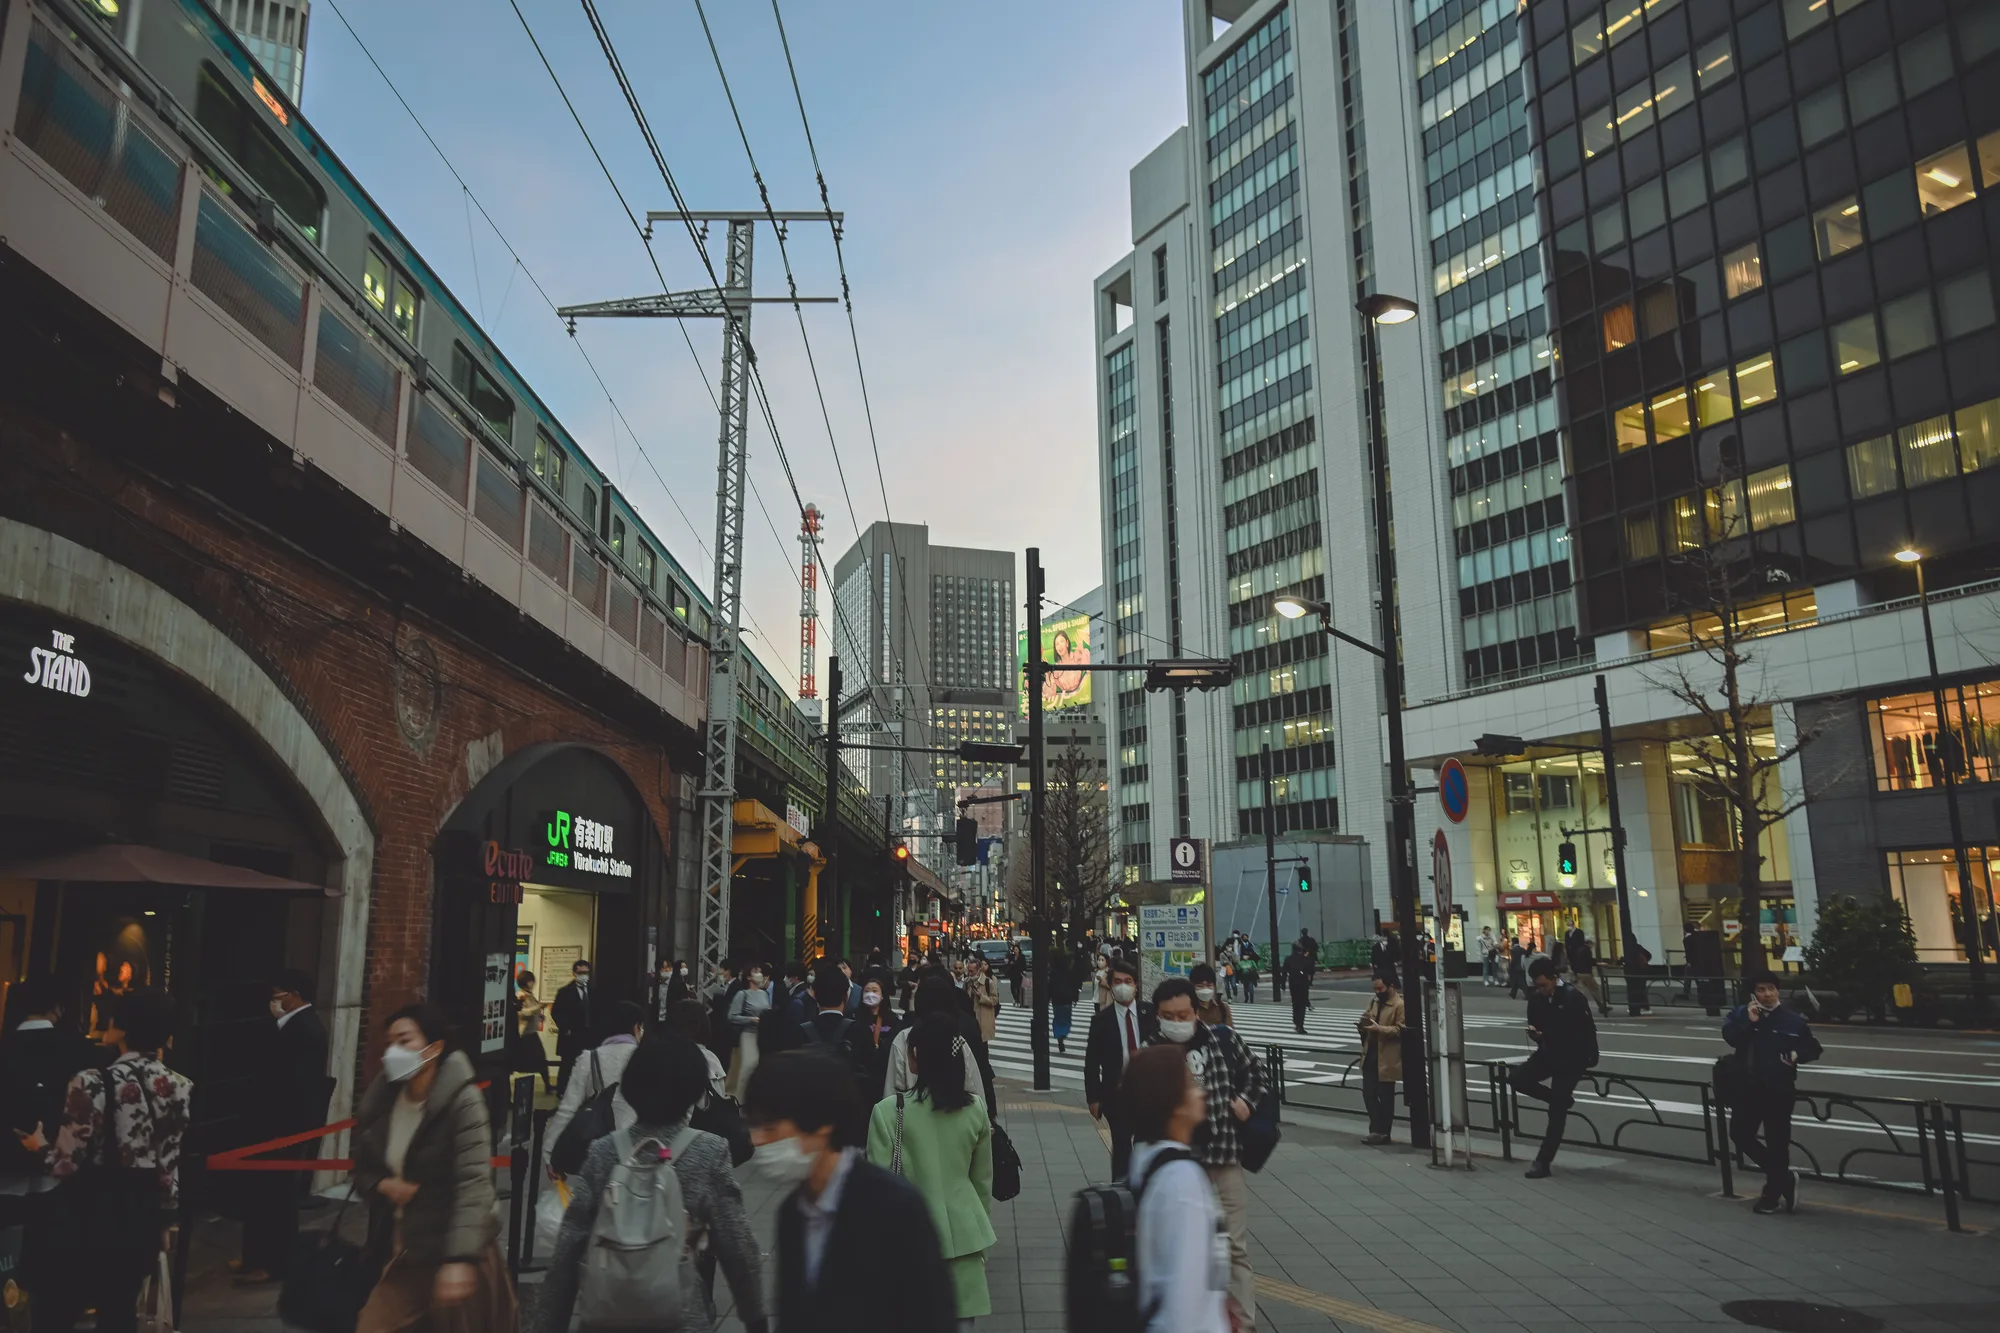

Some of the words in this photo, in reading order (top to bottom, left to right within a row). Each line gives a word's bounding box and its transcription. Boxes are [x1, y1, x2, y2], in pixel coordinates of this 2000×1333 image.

[52, 630, 75, 654] THE
[24, 646, 91, 698] STAND
[547, 810, 571, 849] JR
[574, 816, 614, 854] 有楽町駅
[573, 850, 609, 875] Yūrakuchō
[609, 857, 632, 878] Station
[1168, 931, 1199, 941] 日比谷公園
